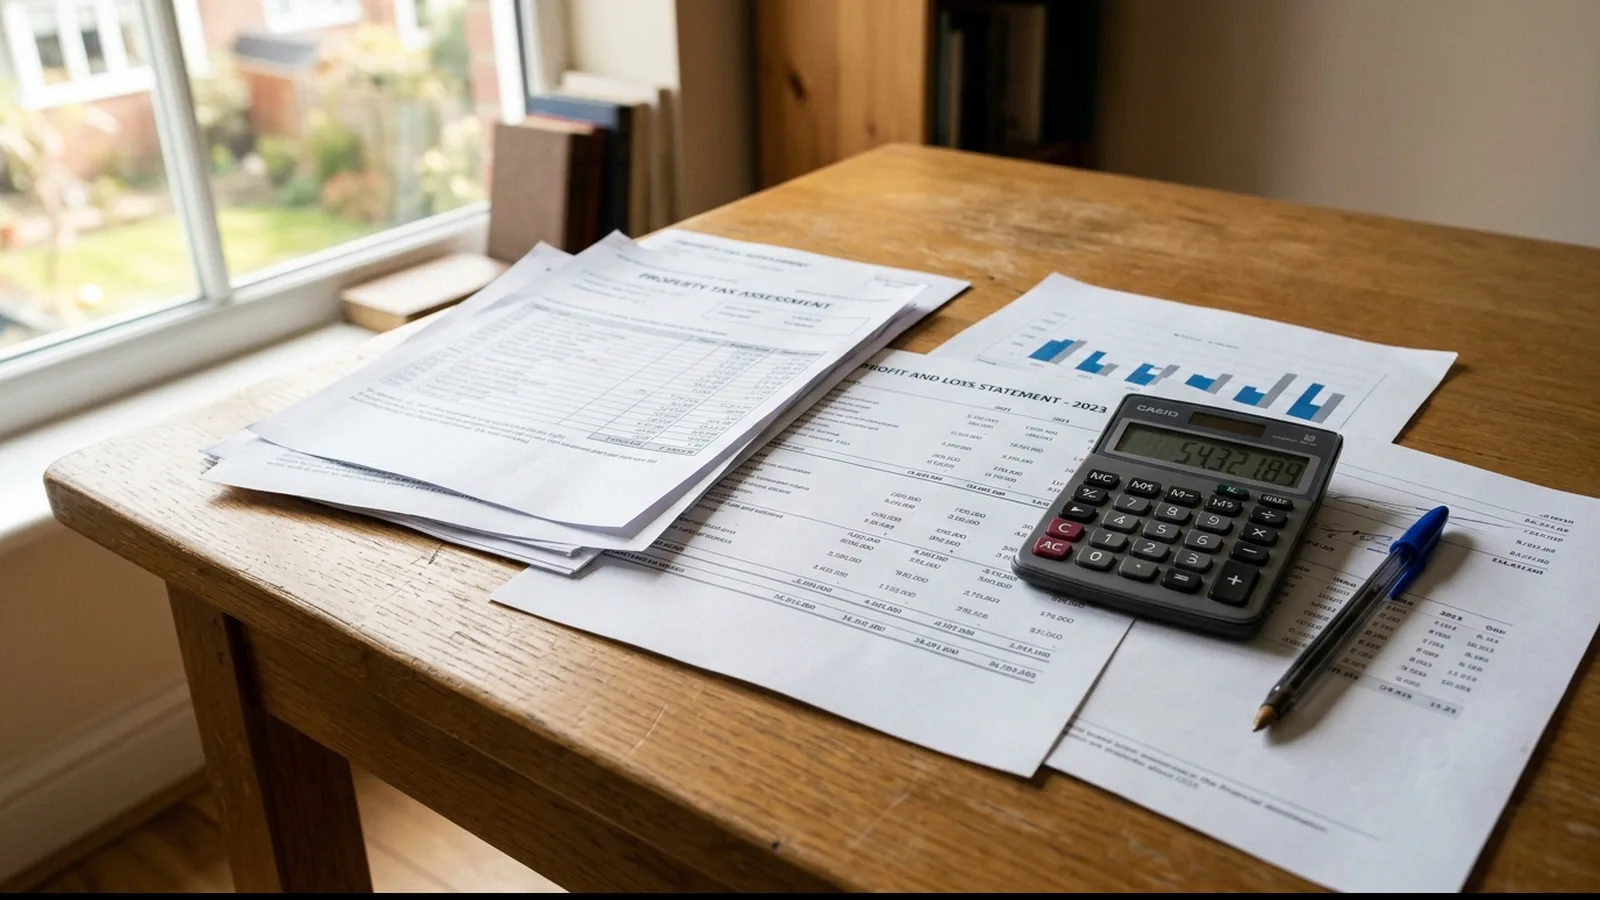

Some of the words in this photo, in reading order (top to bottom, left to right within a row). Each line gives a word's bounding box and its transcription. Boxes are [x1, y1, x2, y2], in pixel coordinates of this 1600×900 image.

[711, 285, 738, 295] TAX
[909, 372, 940, 382] AND
[979, 383, 1062, 404] STATEMENT
[1071, 400, 1108, 415] 2023
[1136, 404, 1179, 418] CASIO
[1089, 471, 1113, 483] MC
[1127, 497, 1137, 507] 7
[1166, 506, 1179, 516] 8
[1207, 515, 1220, 525] 9
[1058, 522, 1072, 534] C
[1156, 524, 1167, 534] 5
[1104, 533, 1112, 543] 1
[1196, 535, 1209, 545] 6
[1039, 540, 1064, 552] AC
[1143, 542, 1156, 553] 2
[1089, 551, 1102, 562] 0
[1186, 552, 1199, 564] 3
